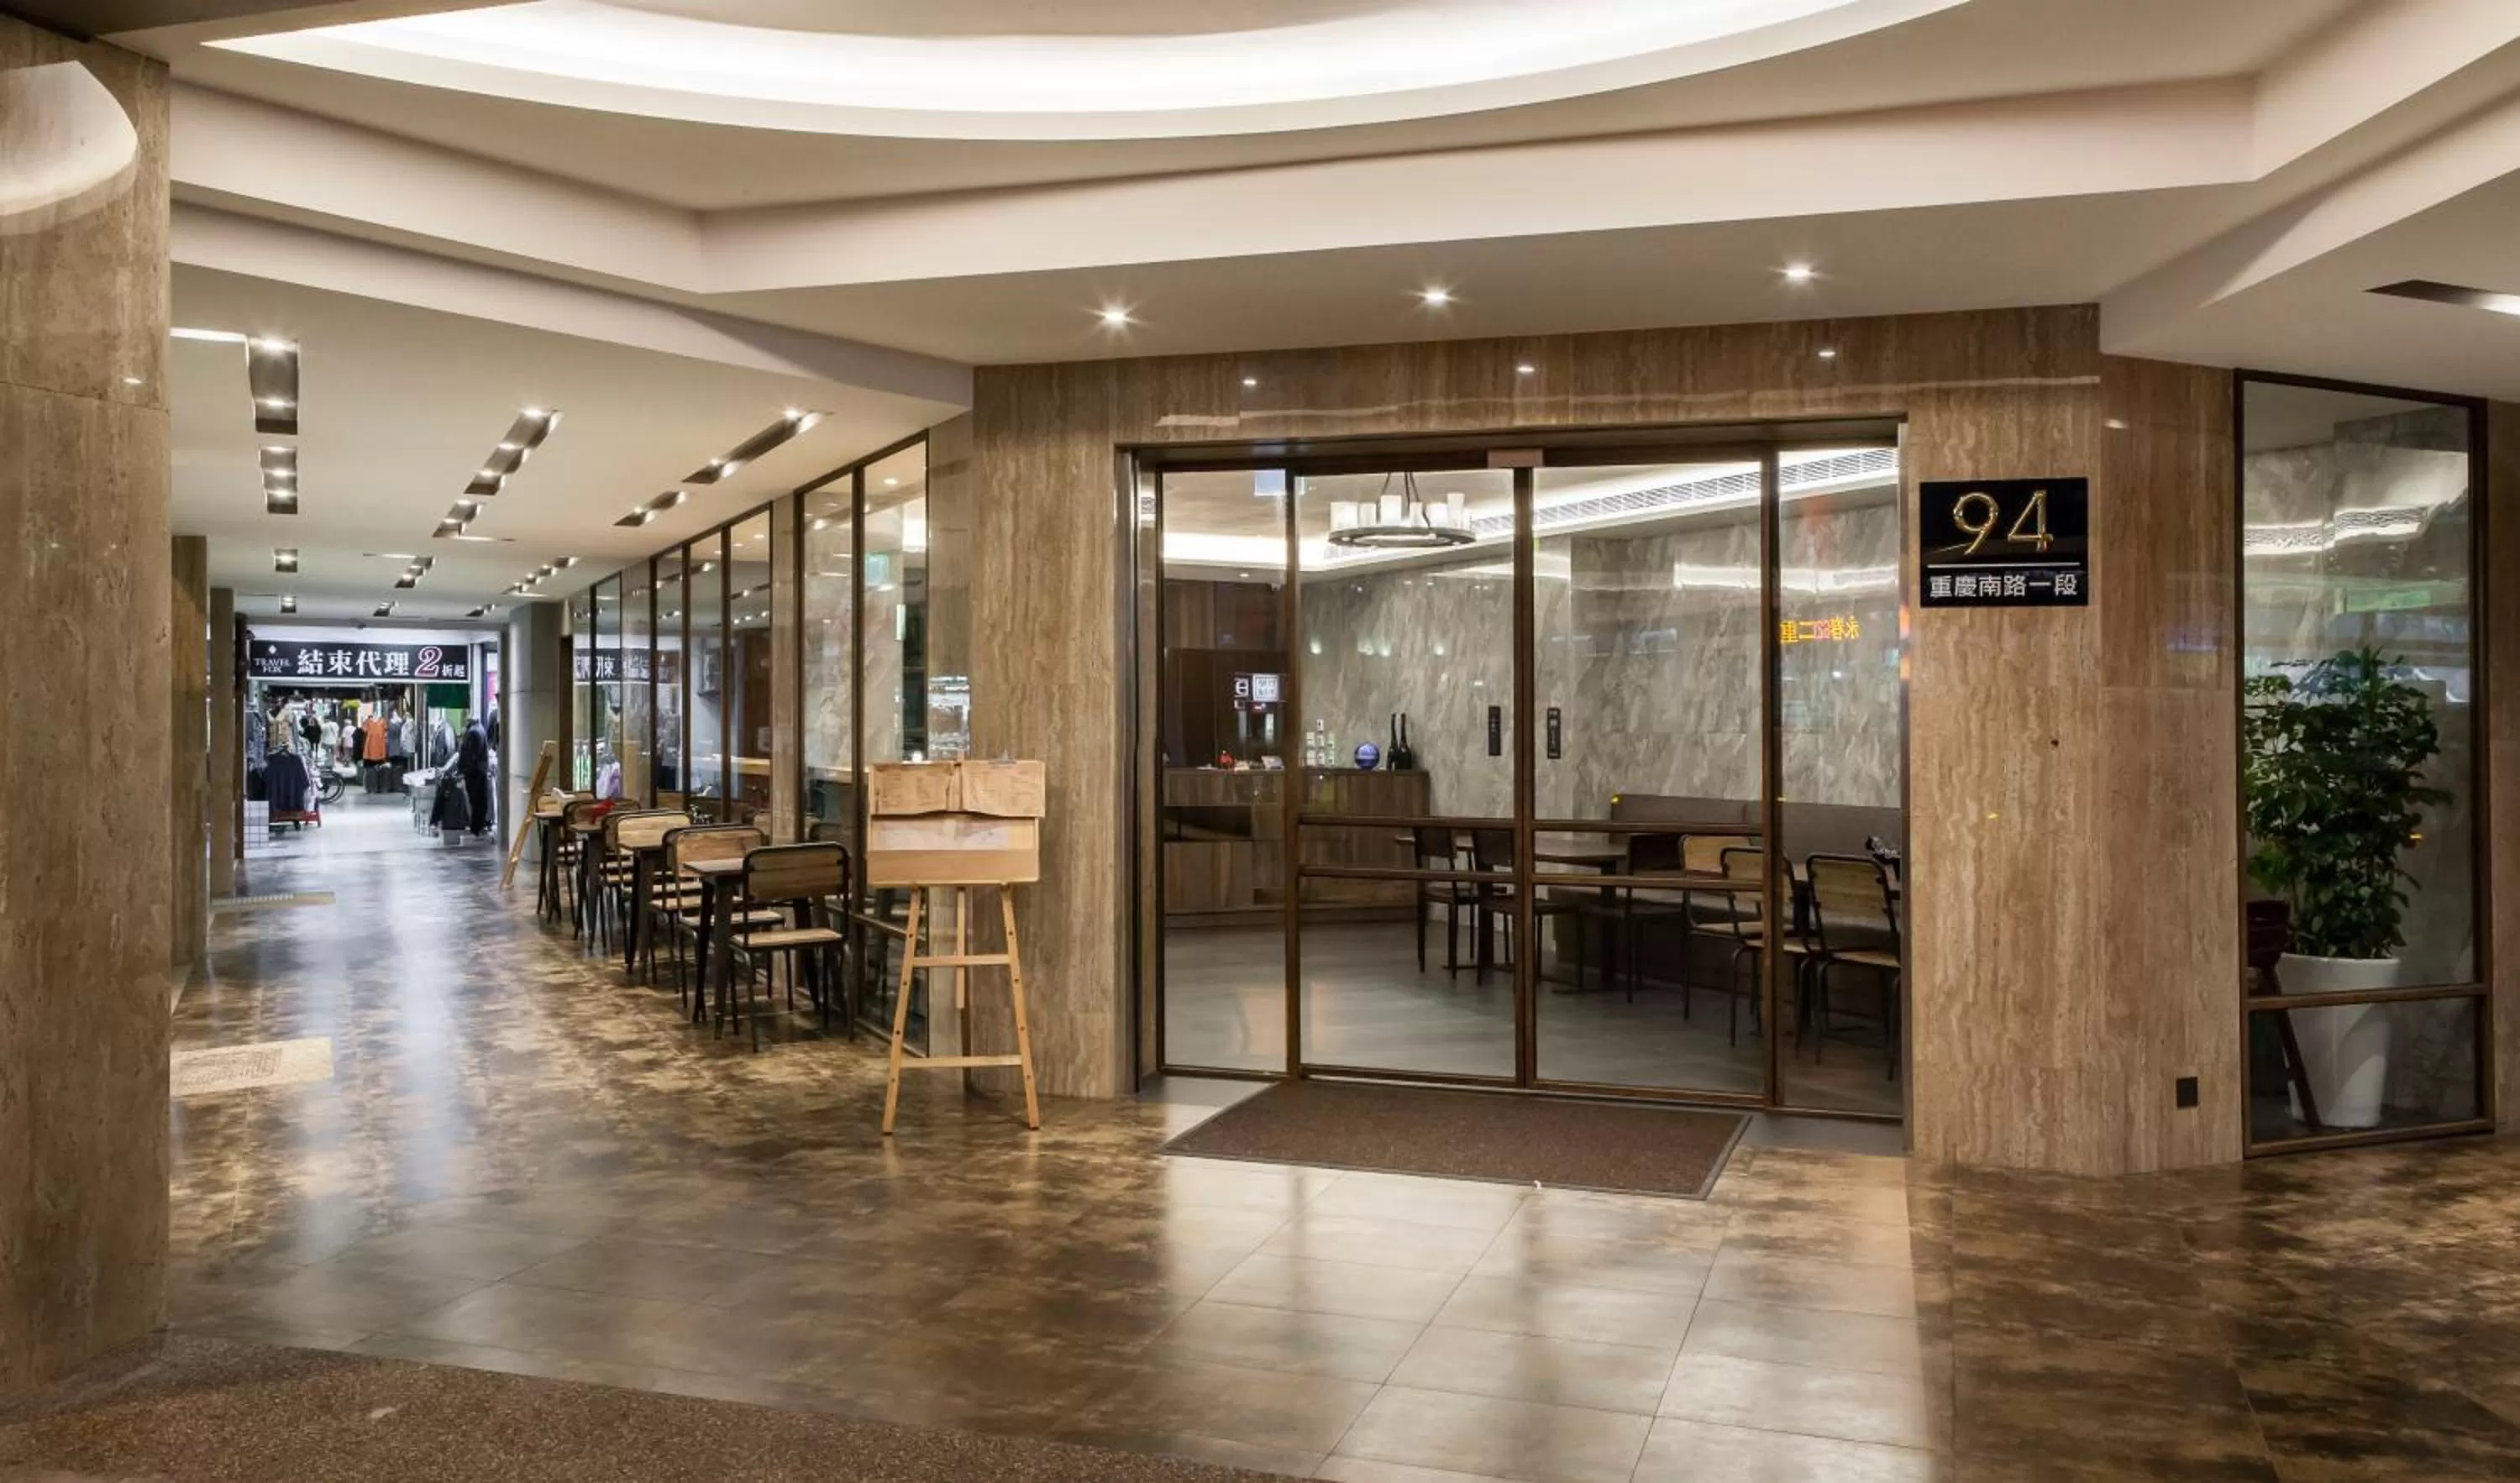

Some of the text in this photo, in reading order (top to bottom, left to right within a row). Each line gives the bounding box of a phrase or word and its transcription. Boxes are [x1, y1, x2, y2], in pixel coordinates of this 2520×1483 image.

[1953, 490, 2054, 555] 94
[1929, 574, 2078, 597] 重慶南路一段
